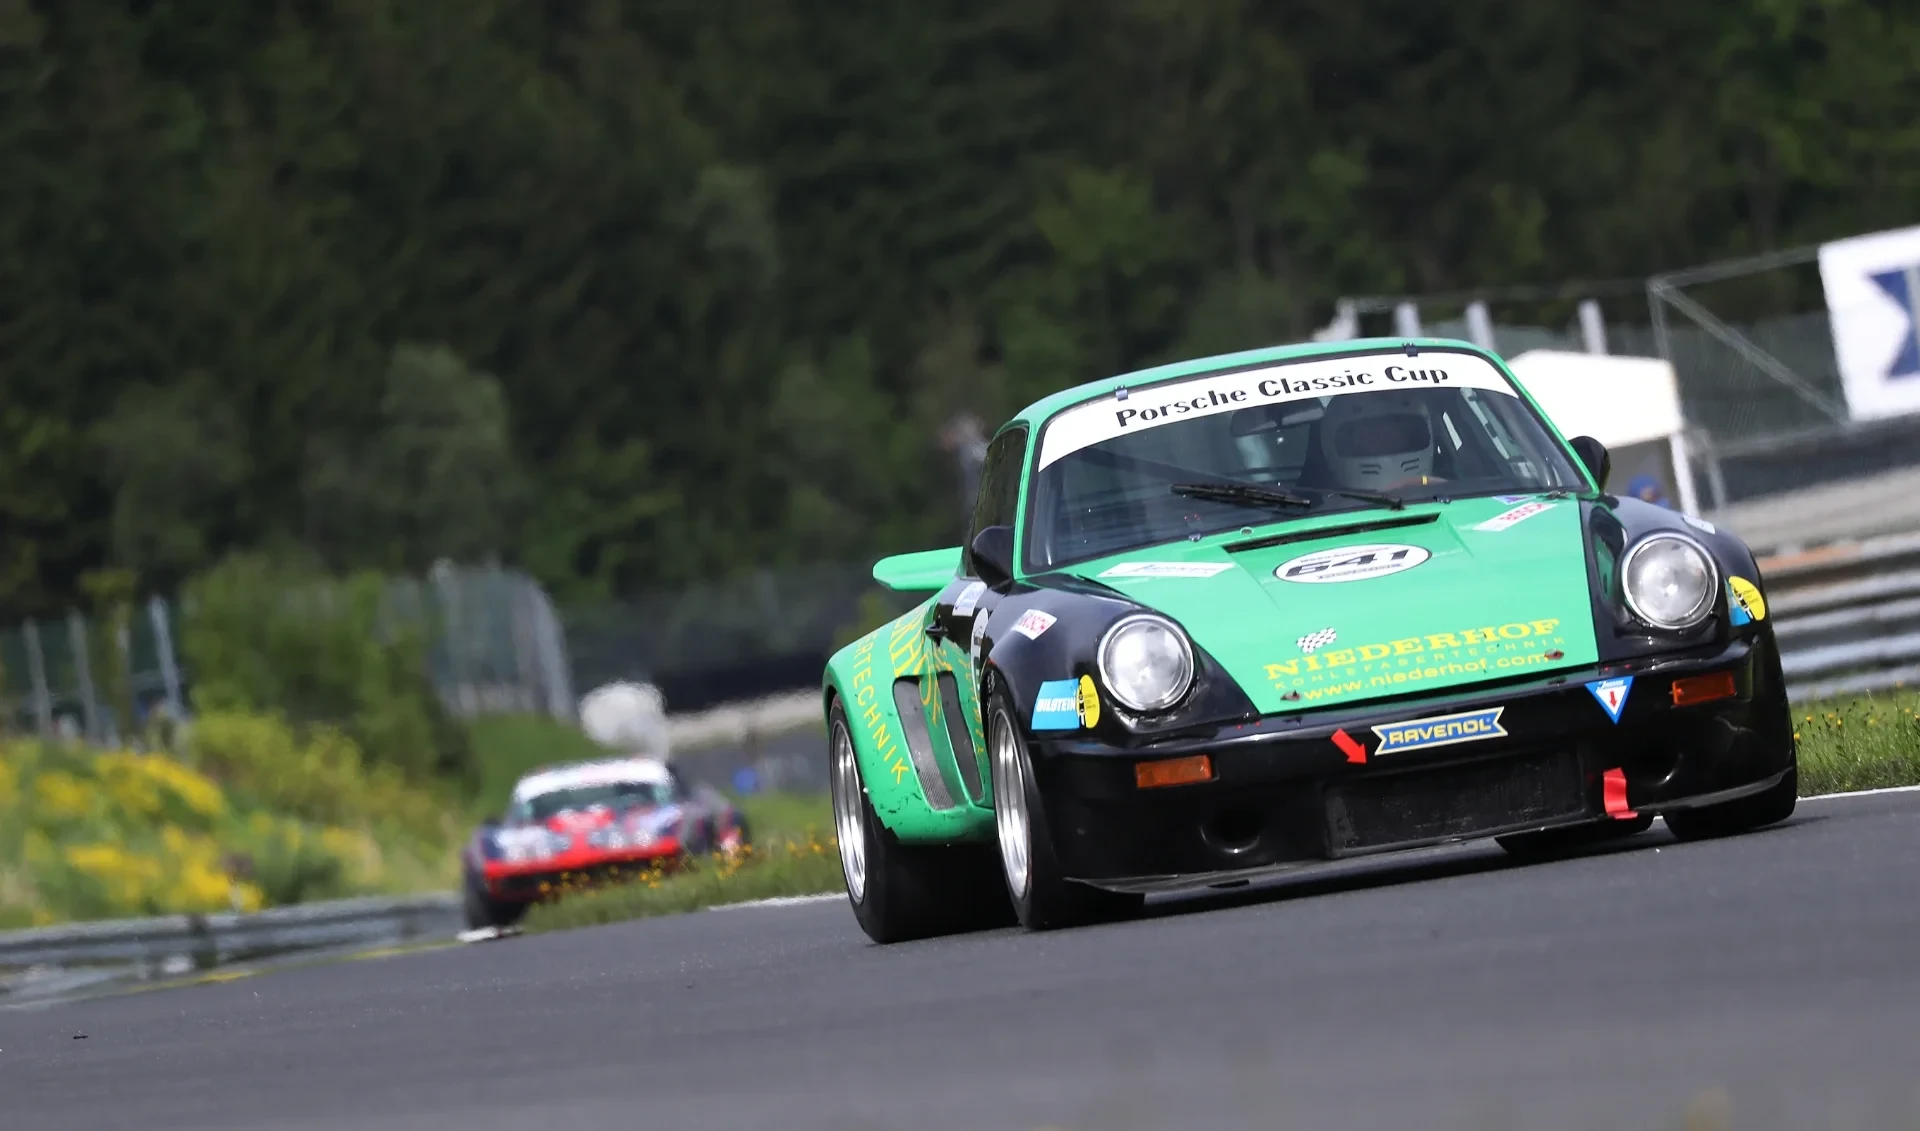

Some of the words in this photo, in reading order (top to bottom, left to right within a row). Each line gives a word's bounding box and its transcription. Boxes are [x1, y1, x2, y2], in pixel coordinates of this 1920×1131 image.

[1115, 389, 1248, 428] Porsche
[1257, 370, 1375, 398] Classic
[1384, 365, 1449, 384] Cup
[1285, 549, 1410, 577] 641
[1263, 618, 1560, 680] NIEDERHOF
[1274, 636, 1565, 690] KOHLEFASERTECHNIK
[1304, 653, 1549, 700] www.niederhof.com
[1036, 697, 1077, 713] BILSTEIN
[1389, 718, 1492, 746] RAVENOL
